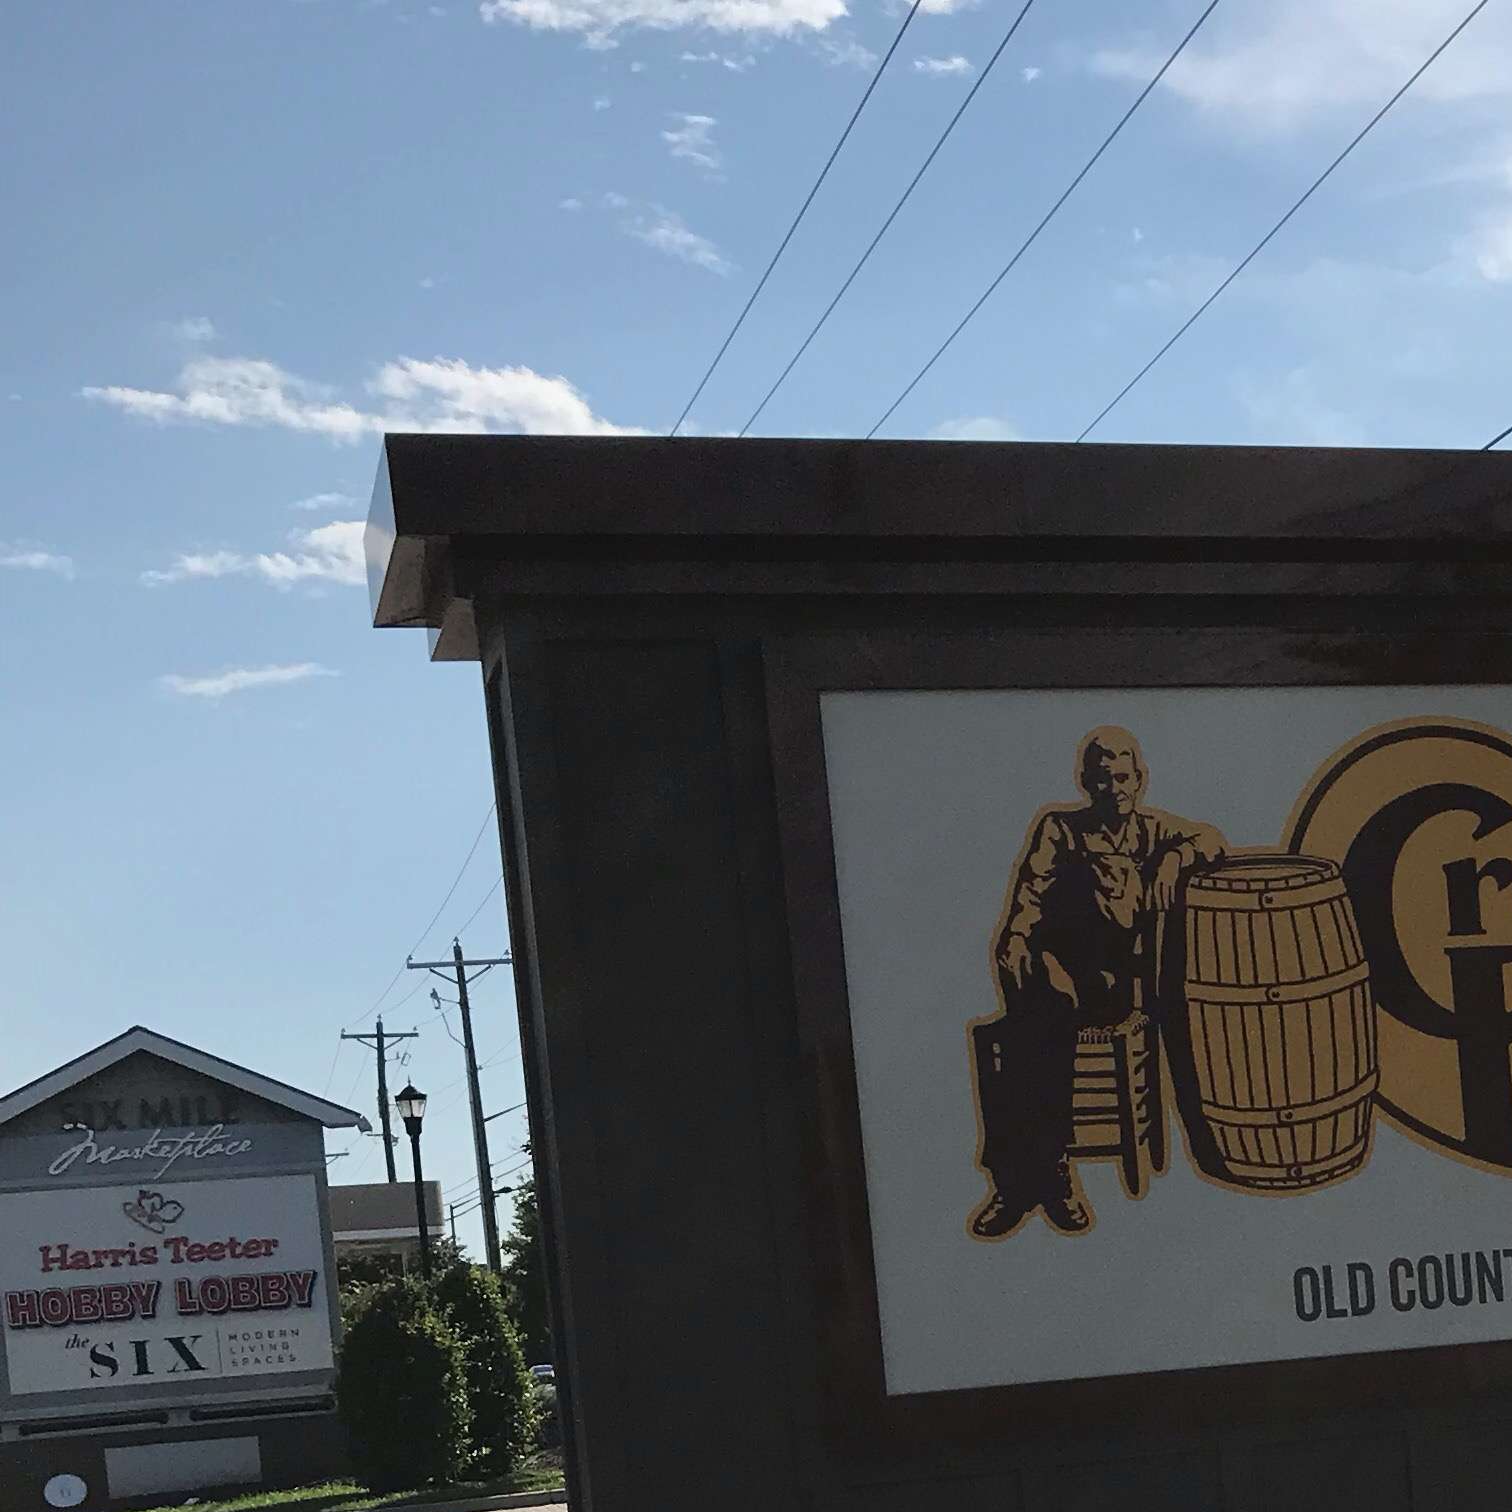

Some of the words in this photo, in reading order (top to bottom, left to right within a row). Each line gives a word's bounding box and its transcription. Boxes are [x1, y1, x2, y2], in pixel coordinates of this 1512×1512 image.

[48, 1119, 253, 1180] Marketplace
[38, 1243, 159, 1272] Harris
[163, 1236, 279, 1264] Teeter
[4, 1281, 162, 1330] HOBBY
[175, 1270, 318, 1316] LOBBY
[1293, 1261, 1376, 1322] OLD
[228, 1328, 300, 1342] MODERN
[230, 1341, 290, 1355] LIVING
[64, 1334, 90, 1350] the
[89, 1335, 209, 1378] SIX
[231, 1354, 297, 1367] SPACES
